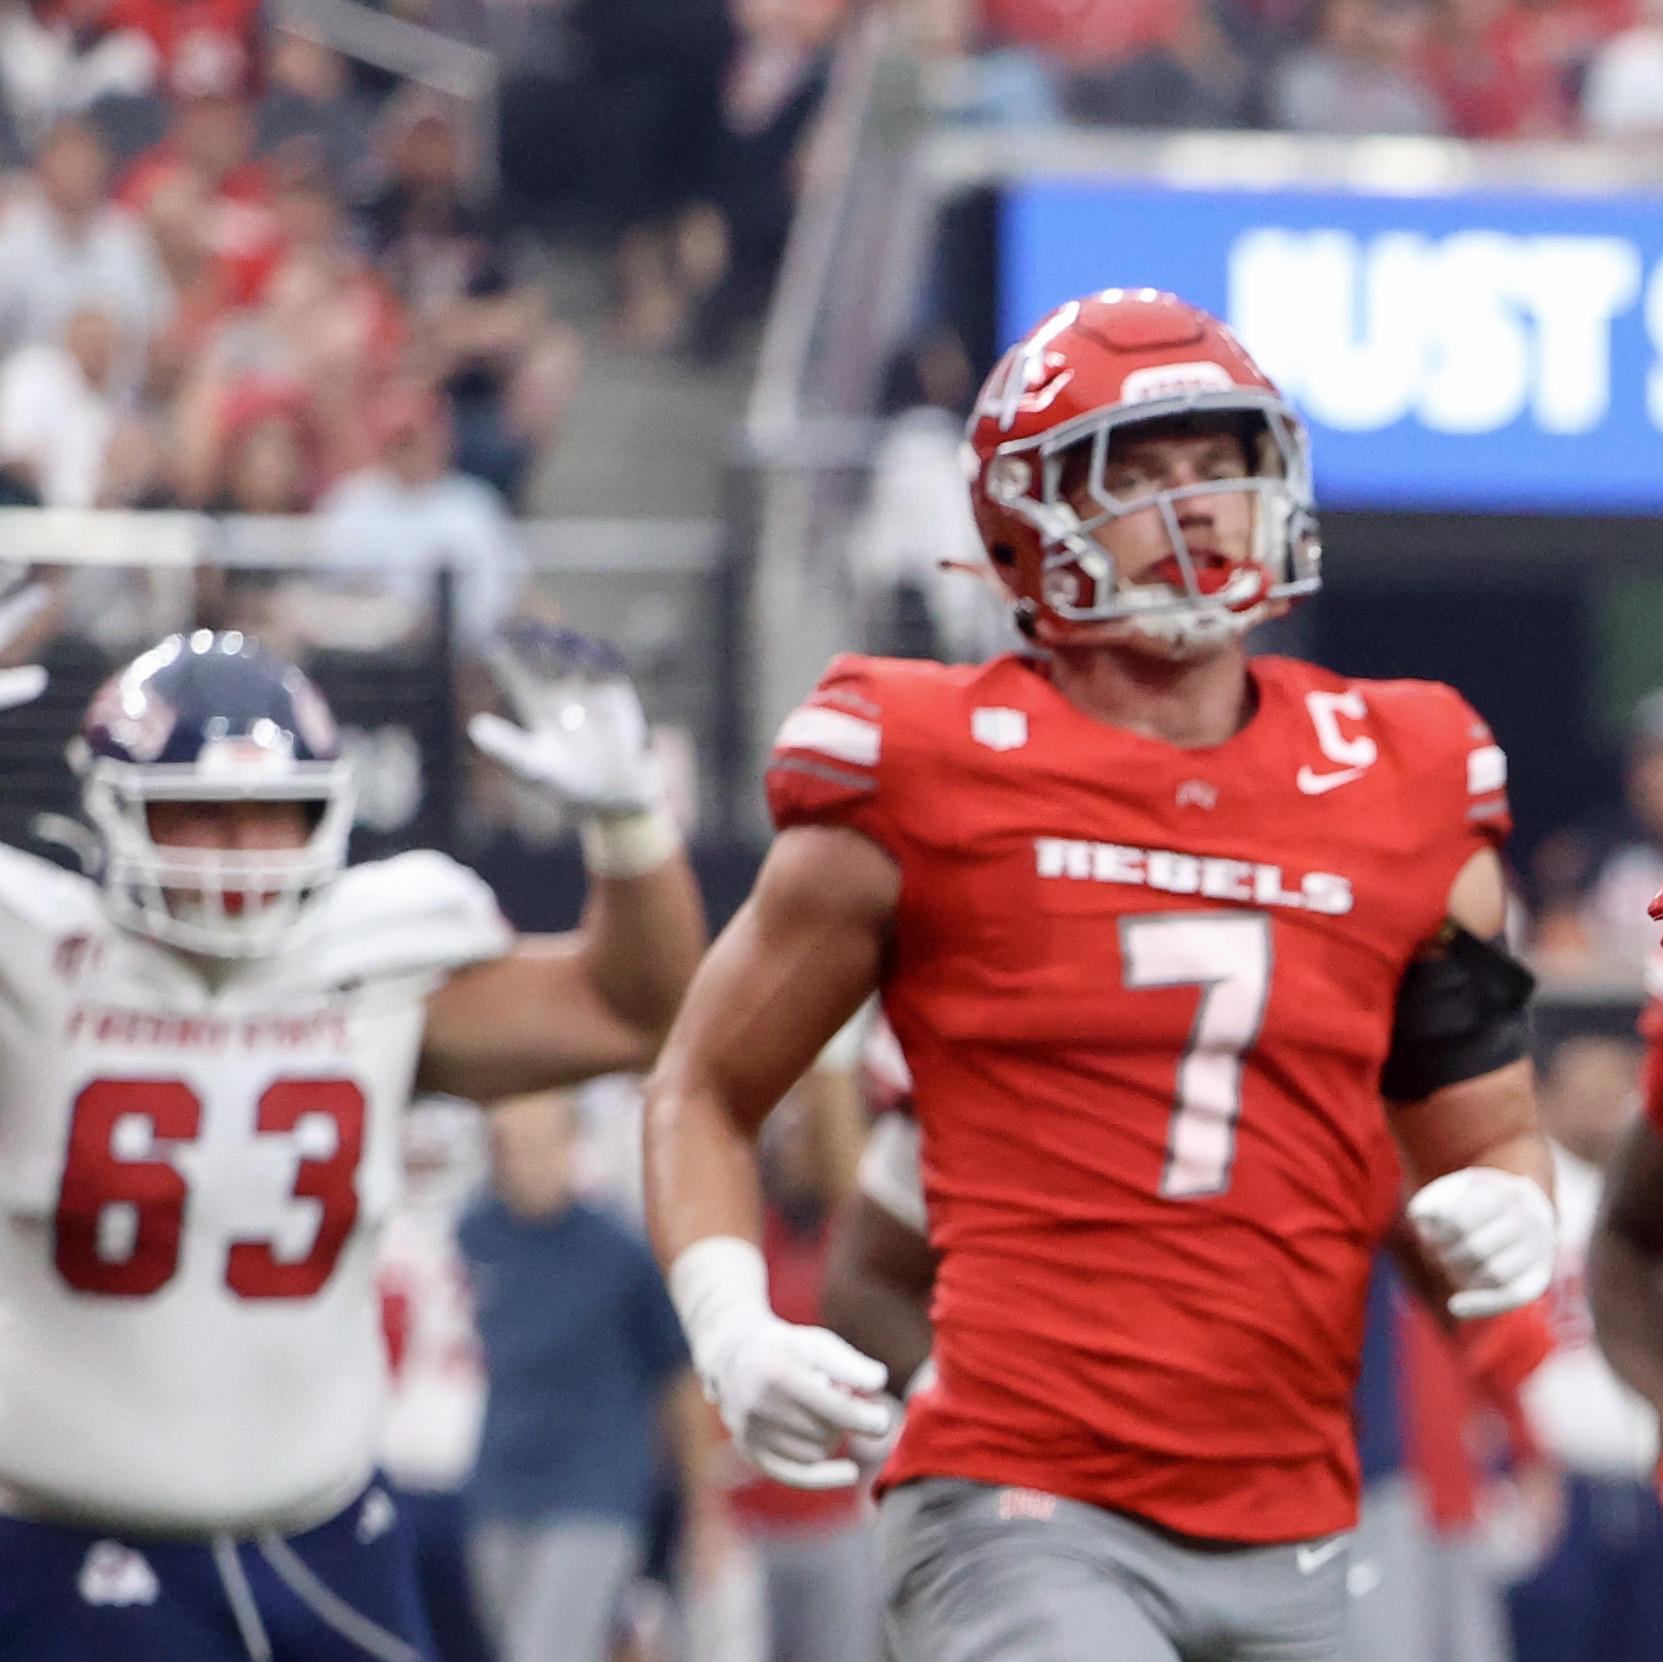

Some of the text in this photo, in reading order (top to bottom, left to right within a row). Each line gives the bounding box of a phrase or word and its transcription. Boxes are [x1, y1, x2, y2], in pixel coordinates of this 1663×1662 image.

[1228, 228, 1637, 434] JUST
[1034, 836, 1354, 914] REBELS
[1118, 910, 1272, 1197] 7
[52, 1076, 366, 1300] 63
